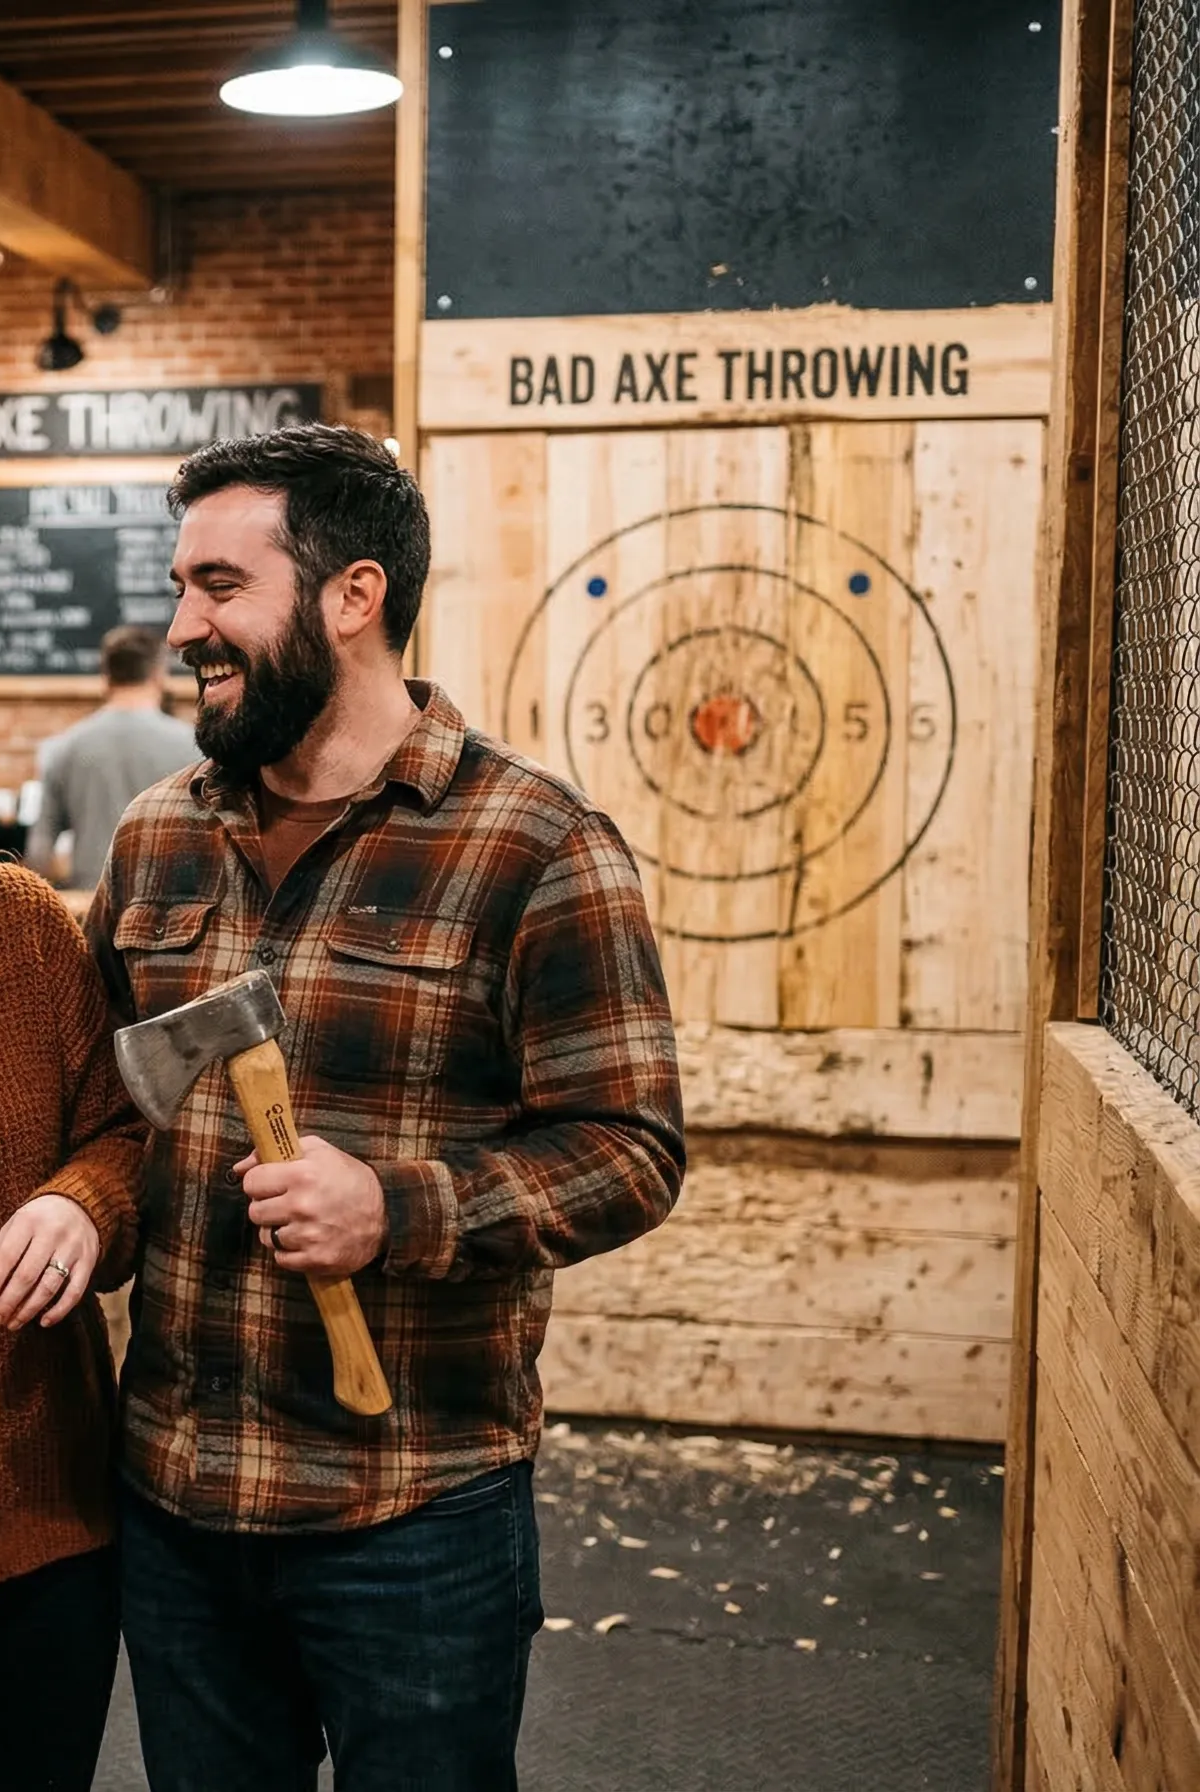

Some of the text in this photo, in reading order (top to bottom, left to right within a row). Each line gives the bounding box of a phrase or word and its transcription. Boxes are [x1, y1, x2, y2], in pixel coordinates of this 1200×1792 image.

[509, 342, 970, 406] BAD AXE THROWING
[584, 701, 610, 743] 3
[842, 701, 870, 742] 5
